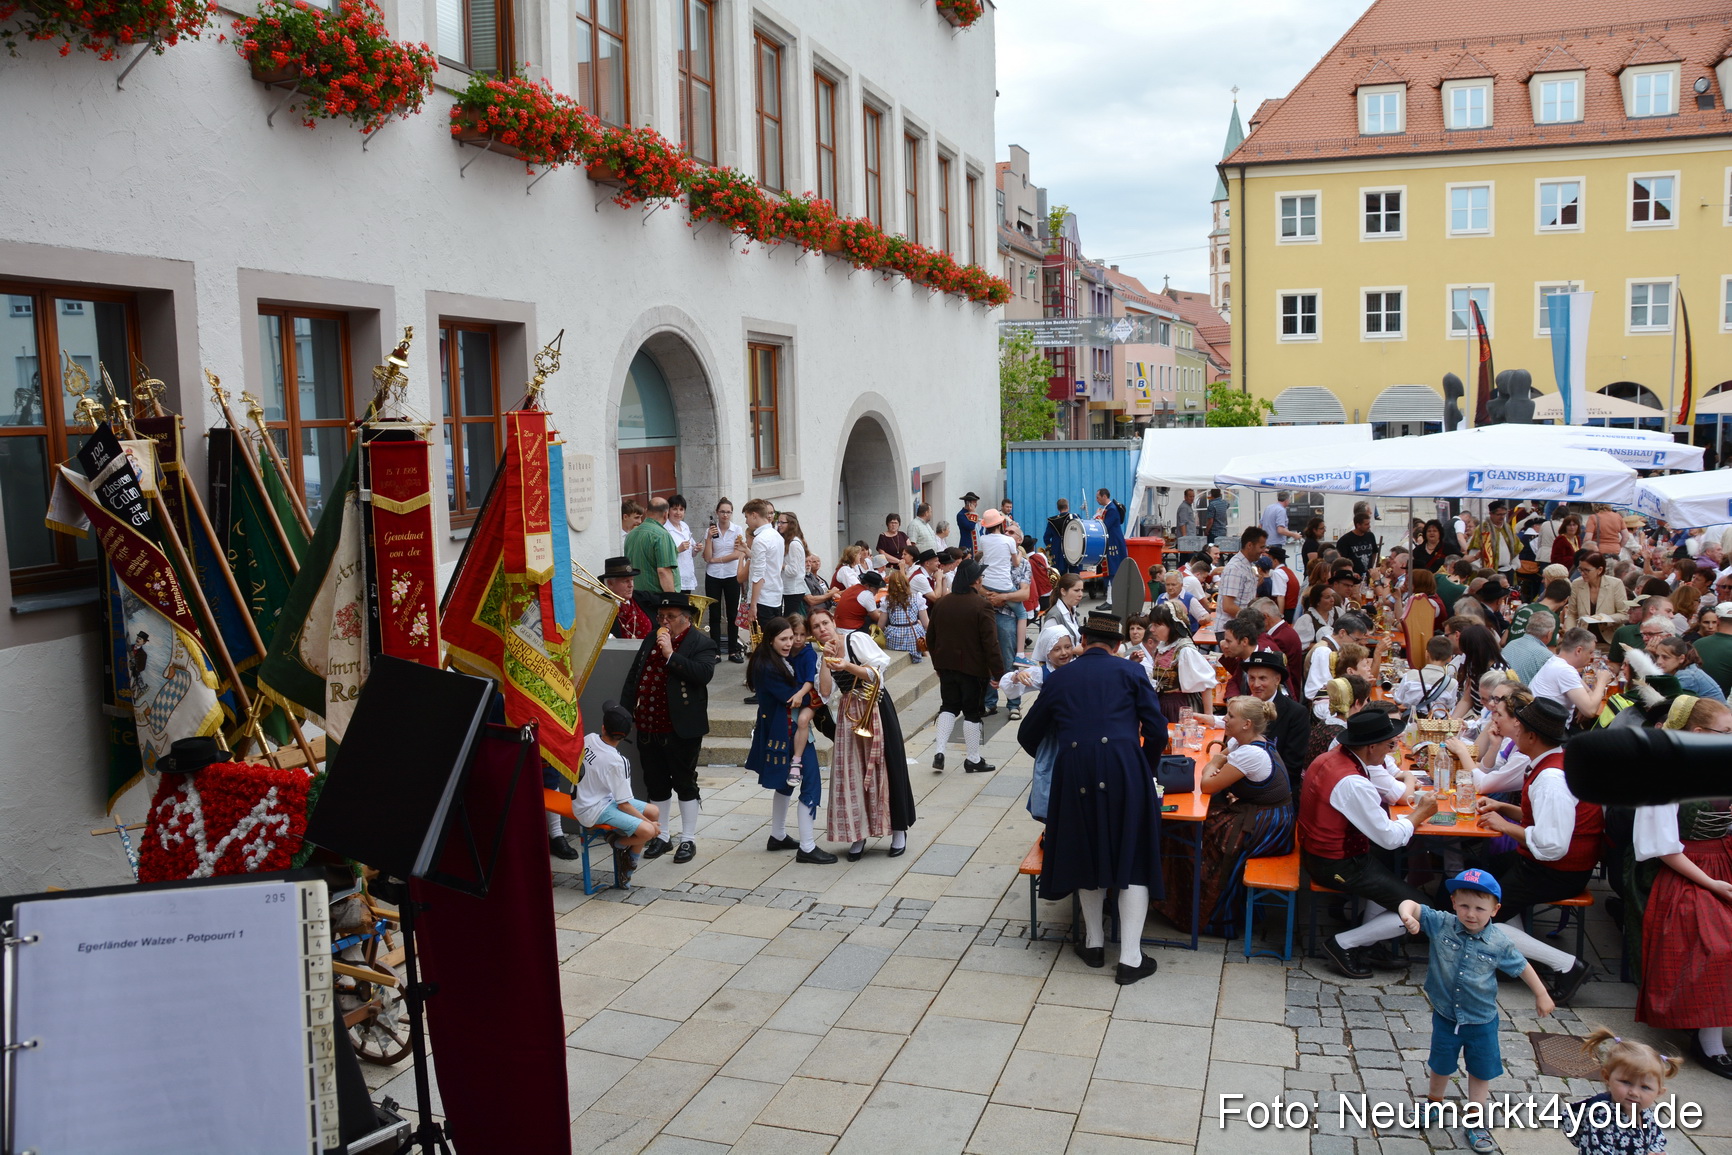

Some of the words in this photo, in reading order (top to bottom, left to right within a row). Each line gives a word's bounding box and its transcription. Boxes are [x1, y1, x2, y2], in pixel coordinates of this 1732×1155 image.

[1137, 380, 1145, 388] B
[91, 441, 104, 461] 100
[1600, 447, 1653, 457] GANSBRÄU
[1279, 470, 1353, 485] GANSBRÄU
[1486, 469, 1567, 483] GANSBRÄU
[129, 503, 143, 514] zur
[384, 530, 425, 546] Gewidmet
[389, 550, 404, 558] von
[407, 547, 422, 557] der
[394, 579, 426, 631] Jugendgruppe
[507, 640, 548, 678] MUENCHEN
[513, 638, 533, 656] UND
[534, 654, 572, 691] UMGEBUNG
[1465, 869, 1482, 877] NEW
[1463, 875, 1480, 884] YORK
[265, 893, 286, 904] 295
[317, 907, 323, 918] 2
[77, 937, 138, 954] Egerländer
[141, 935, 177, 947] Walzer
[186, 930, 236, 943] Potpourri
[238, 929, 244, 938] 1
[315, 939, 321, 950] 4
[321, 993, 327, 1004] 7
[318, 1011, 324, 1020] 8
[320, 1027, 326, 1038] 9
[320, 1082, 333, 1092] 12
[321, 1100, 335, 1111] 13
[325, 1134, 337, 1145] 15
